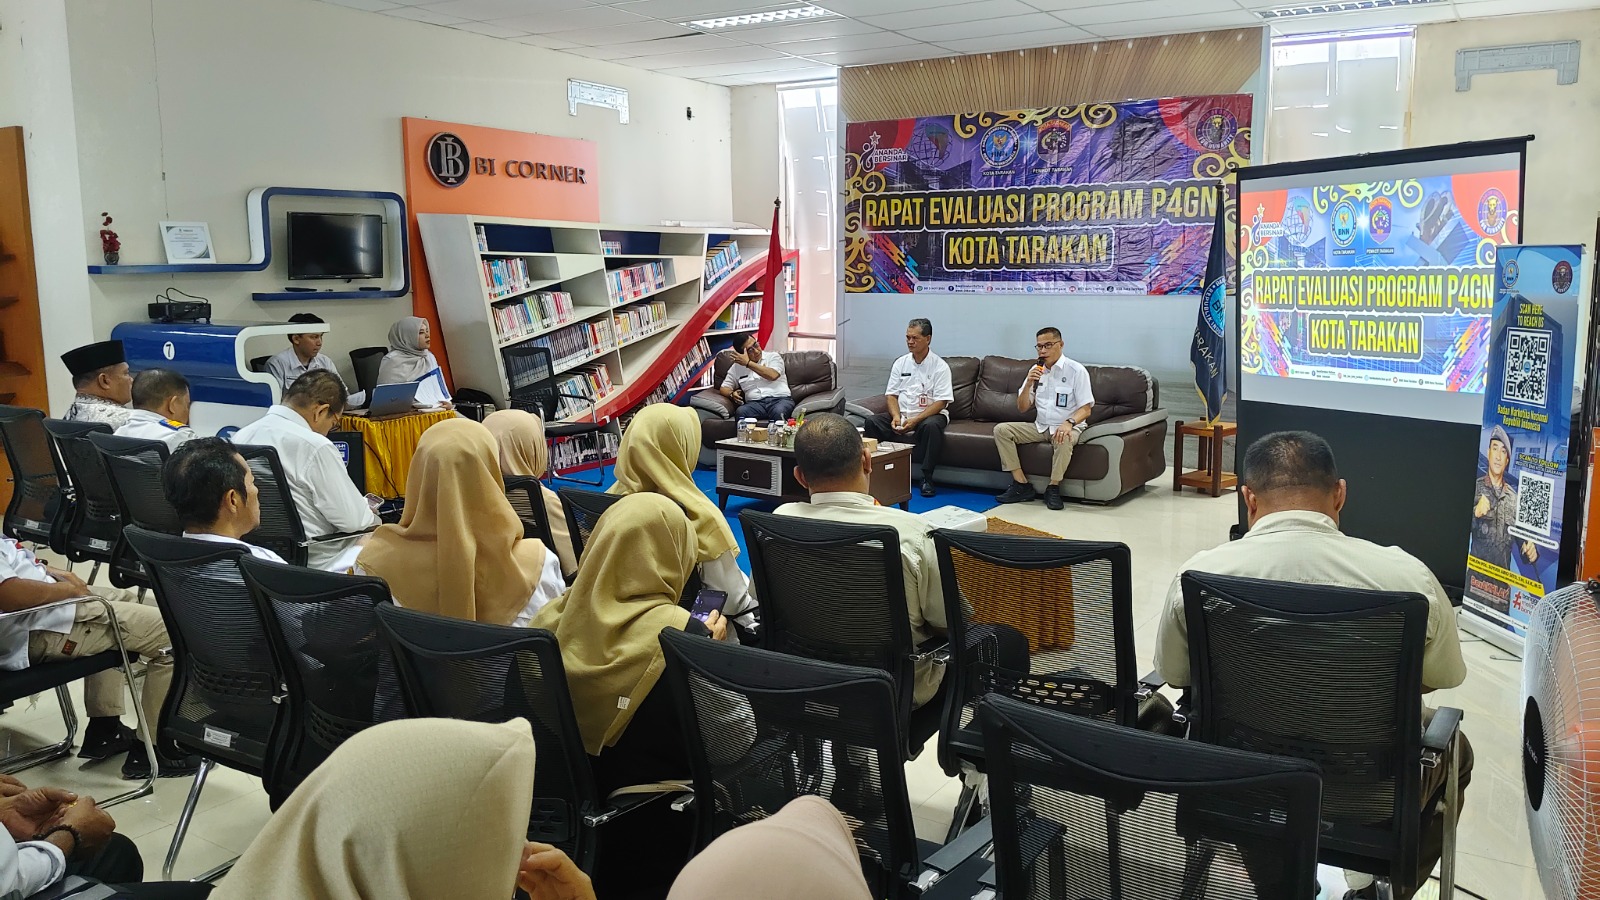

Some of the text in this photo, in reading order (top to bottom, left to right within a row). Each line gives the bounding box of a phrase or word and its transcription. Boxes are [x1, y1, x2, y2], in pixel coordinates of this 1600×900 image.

[475, 157, 587, 184] BI CORNER
[865, 186, 1217, 227] RAPAT EVALUASI PROGRAM P4GN
[949, 234, 1107, 265] KOTA TARAKAN
[1255, 275, 1294, 305] RAPAT
[1298, 275, 1363, 306] EVALUASI
[1367, 274, 1442, 308] PROGRAM
[1447, 273, 1494, 308] P4GN
[1519, 303, 1543, 315] SCAN HERE
[1517, 315, 1544, 328] TO REACH US
[1311, 319, 1418, 354] KOTA TARAKAN
[166, 344, 172, 358] 7
[1497, 404, 1548, 423] Badan Narkotika Nasional
[1521, 419, 1541, 432] Indonesia
[1519, 453, 1531, 461] SCAN
[1538, 459, 1559, 469] FOLLOW
